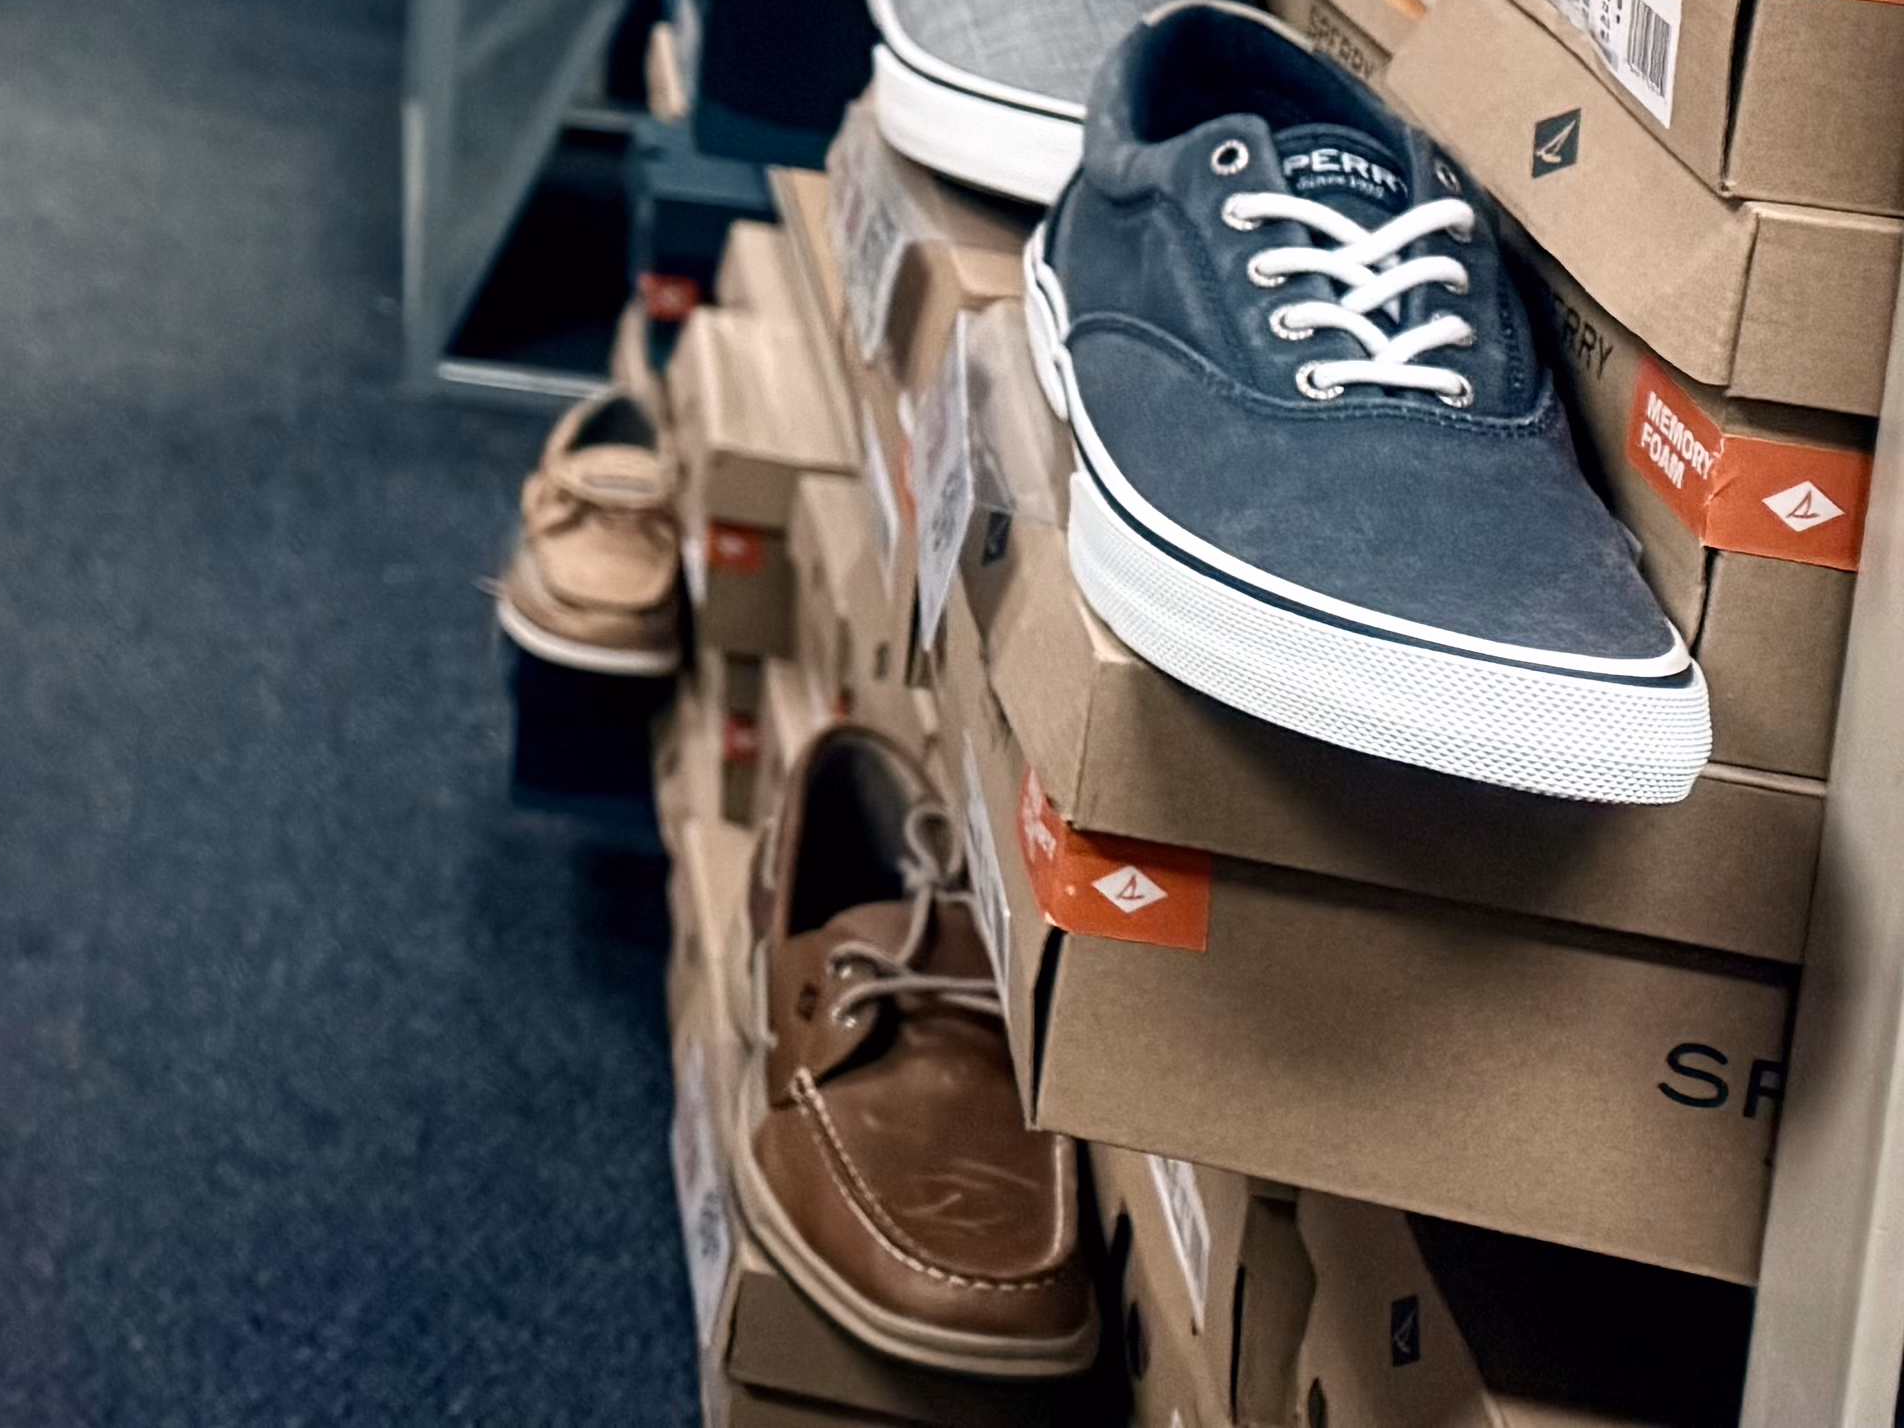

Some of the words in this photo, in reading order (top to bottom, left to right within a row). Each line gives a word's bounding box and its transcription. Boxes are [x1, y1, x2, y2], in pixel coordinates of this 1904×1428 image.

[1283, 147, 1409, 199] PERR
[1640, 421, 1687, 490] FOAM
[1646, 390, 1715, 481] MEMORY
